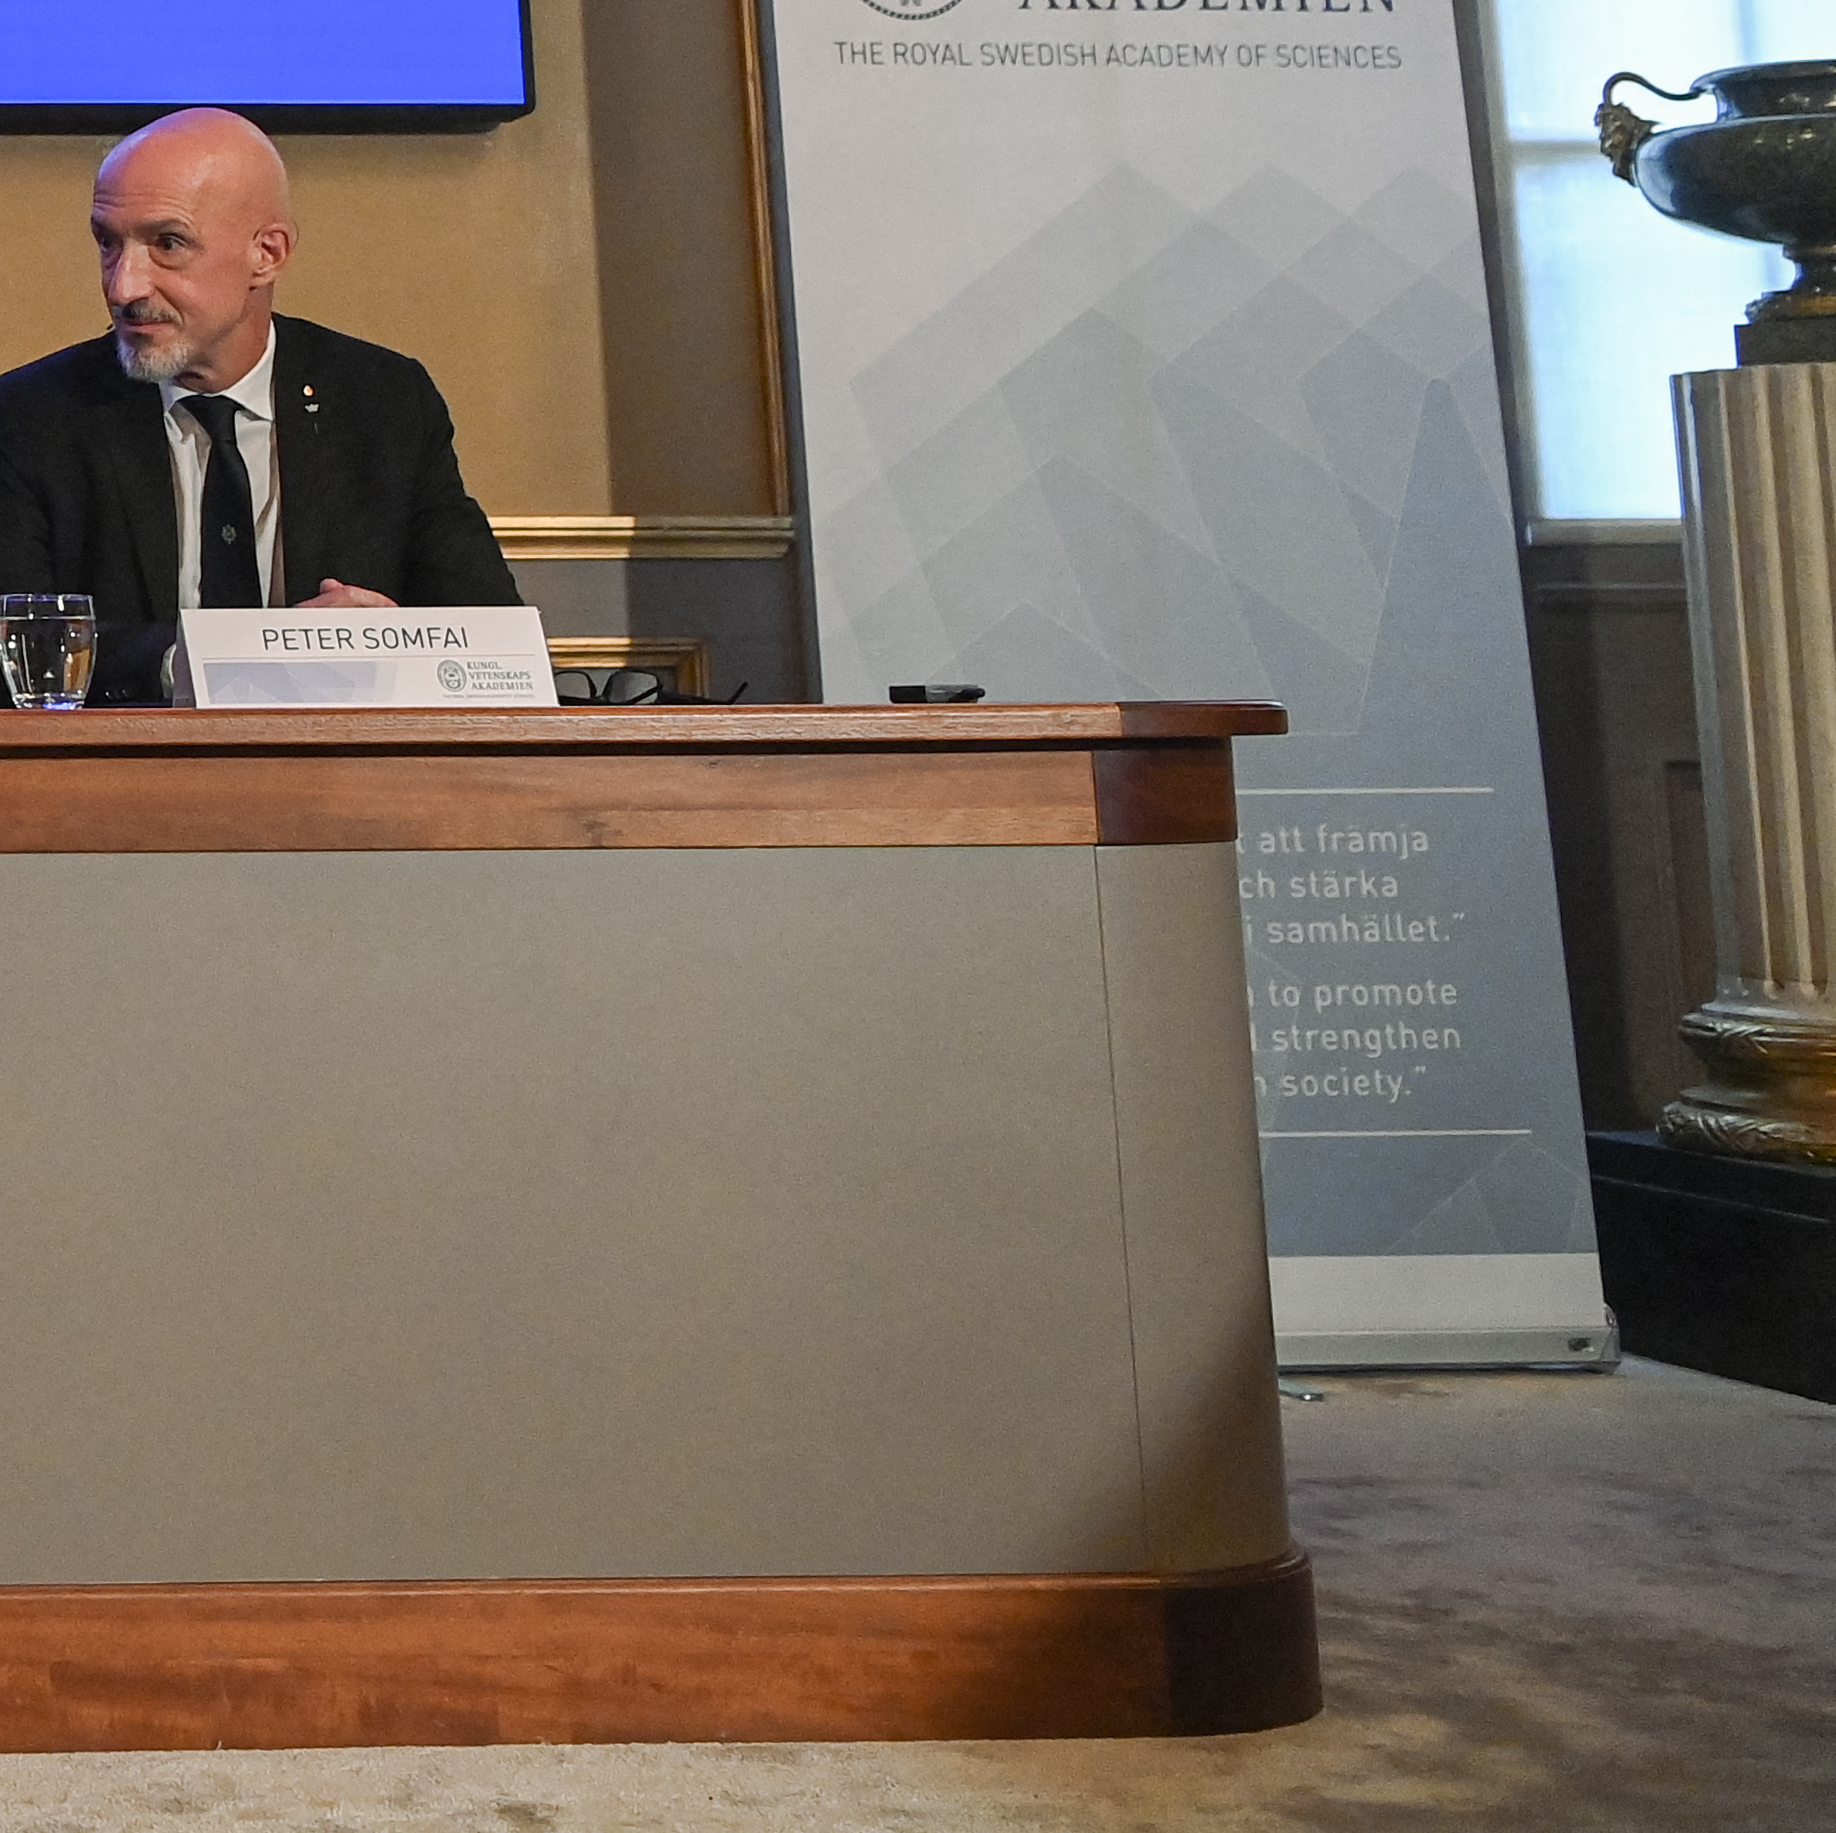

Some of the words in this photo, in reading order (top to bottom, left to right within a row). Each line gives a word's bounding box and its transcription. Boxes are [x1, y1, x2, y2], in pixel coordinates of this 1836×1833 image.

[833, 41, 884, 66] THE
[893, 42, 973, 67] ROYAL
[980, 43, 1097, 67] SWEDISH
[1105, 43, 1228, 68] ACADEMY
[1237, 43, 1267, 67] OF
[1276, 44, 1402, 70] SCIENCES
[262, 628, 355, 651] PETER
[362, 626, 468, 650] SOMFAI
[1259, 826, 1305, 854] att
[1316, 823, 1429, 859] främja
[1290, 869, 1398, 899] stärka
[1268, 979, 1301, 1007] to
[1315, 979, 1458, 1013] promote
[1272, 1023, 1462, 1057] strengthen
